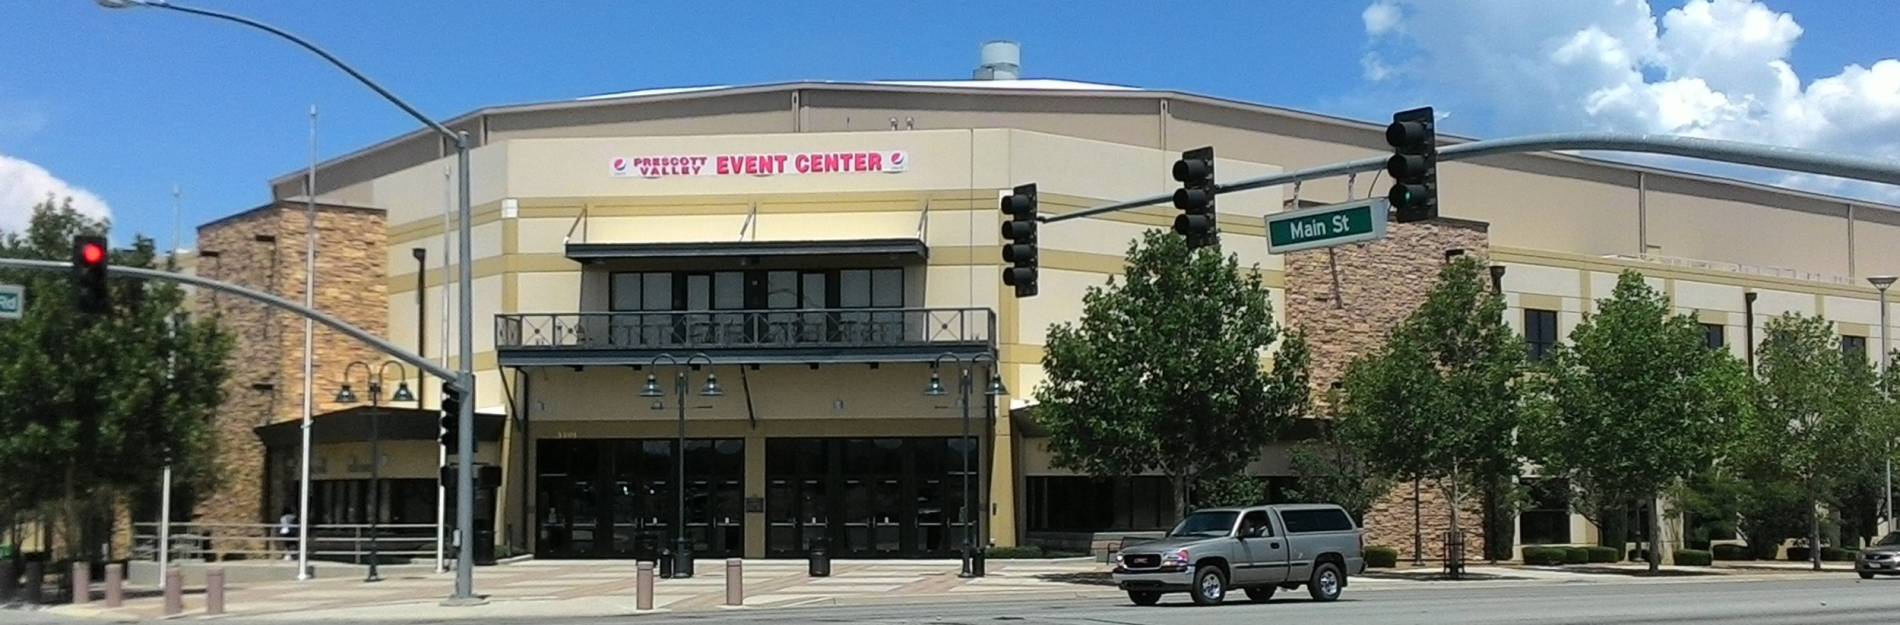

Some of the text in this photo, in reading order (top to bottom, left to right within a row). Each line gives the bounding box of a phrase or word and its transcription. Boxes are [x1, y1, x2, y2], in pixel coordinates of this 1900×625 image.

[633, 156, 707, 167] PRESCOTT
[716, 152, 882, 175] EVENT CENTER
[640, 166, 701, 176] VALLEY
[1290, 214, 1350, 240] Main St
